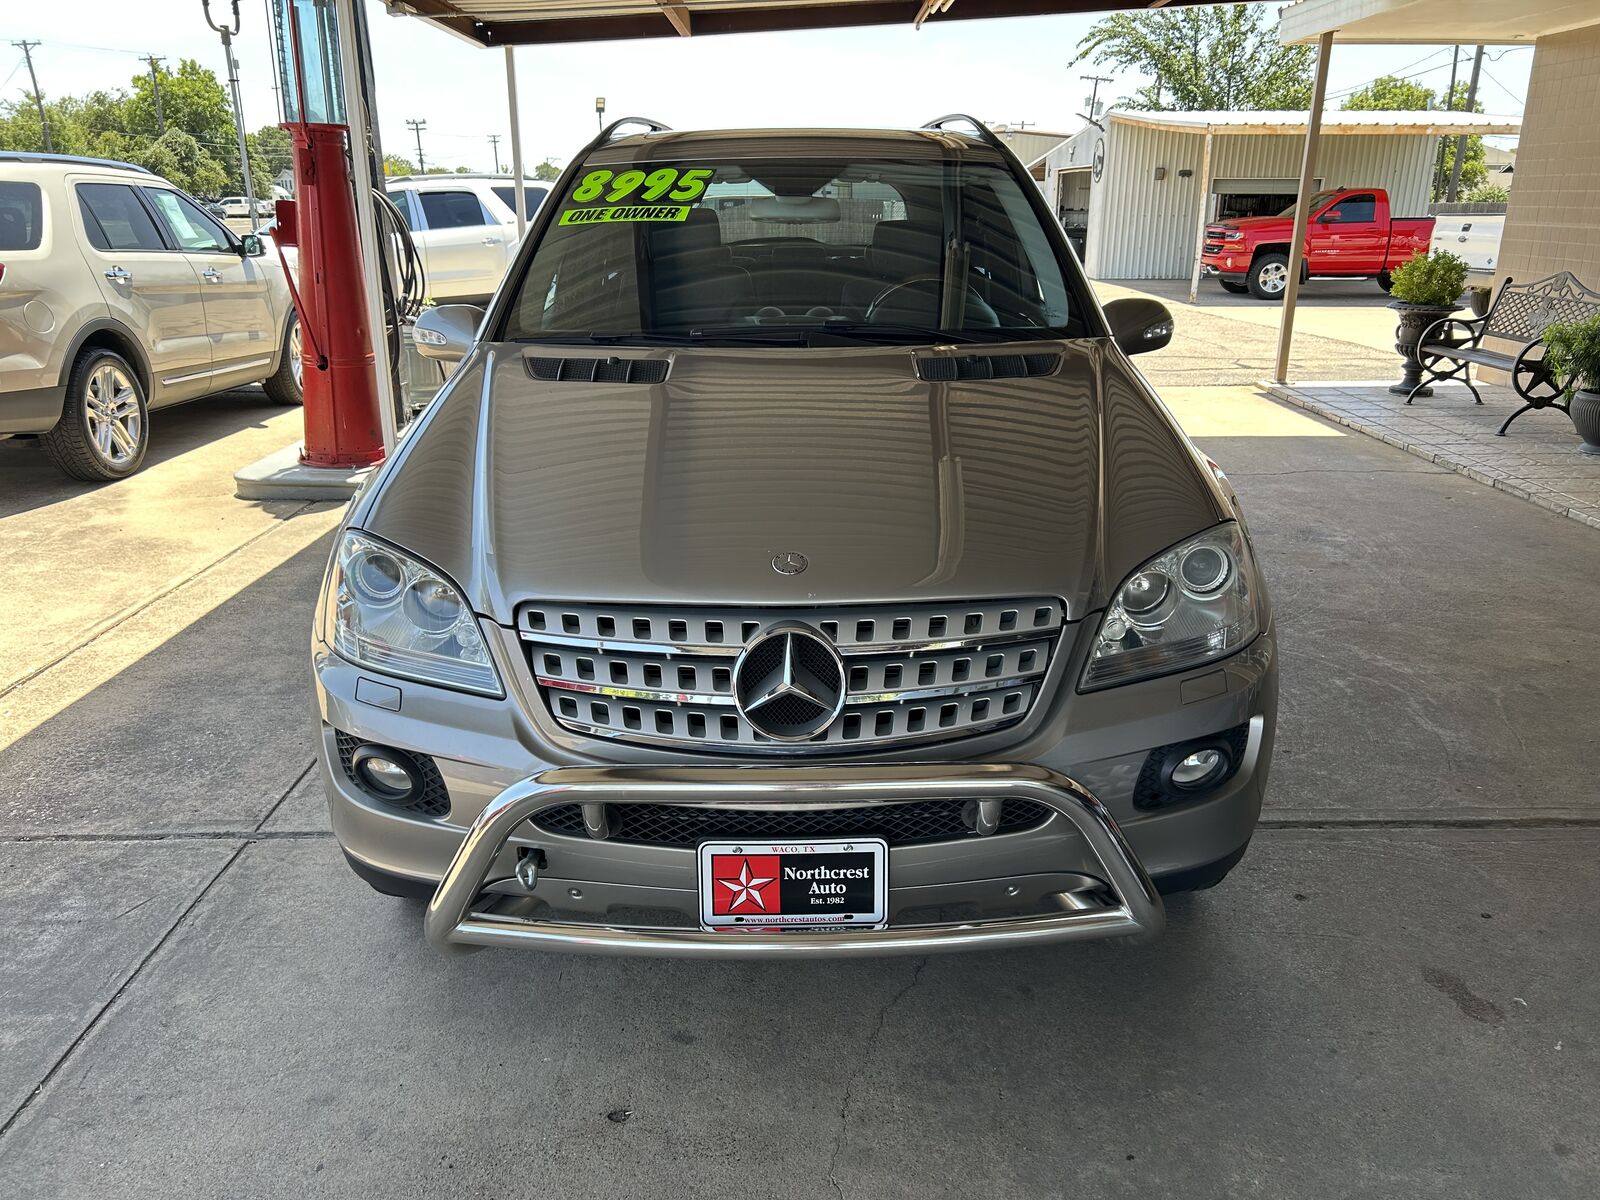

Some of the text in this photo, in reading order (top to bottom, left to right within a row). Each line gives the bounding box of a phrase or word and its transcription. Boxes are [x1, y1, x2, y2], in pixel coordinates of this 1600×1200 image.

[572, 168, 714, 202] 8995
[567, 207, 681, 223] ONE OWNER
[783, 866, 869, 880] Northcrest
[808, 882, 847, 895] Auto
[810, 897, 825, 905] Est.
[744, 915, 845, 923] www.northcrestautos.com
